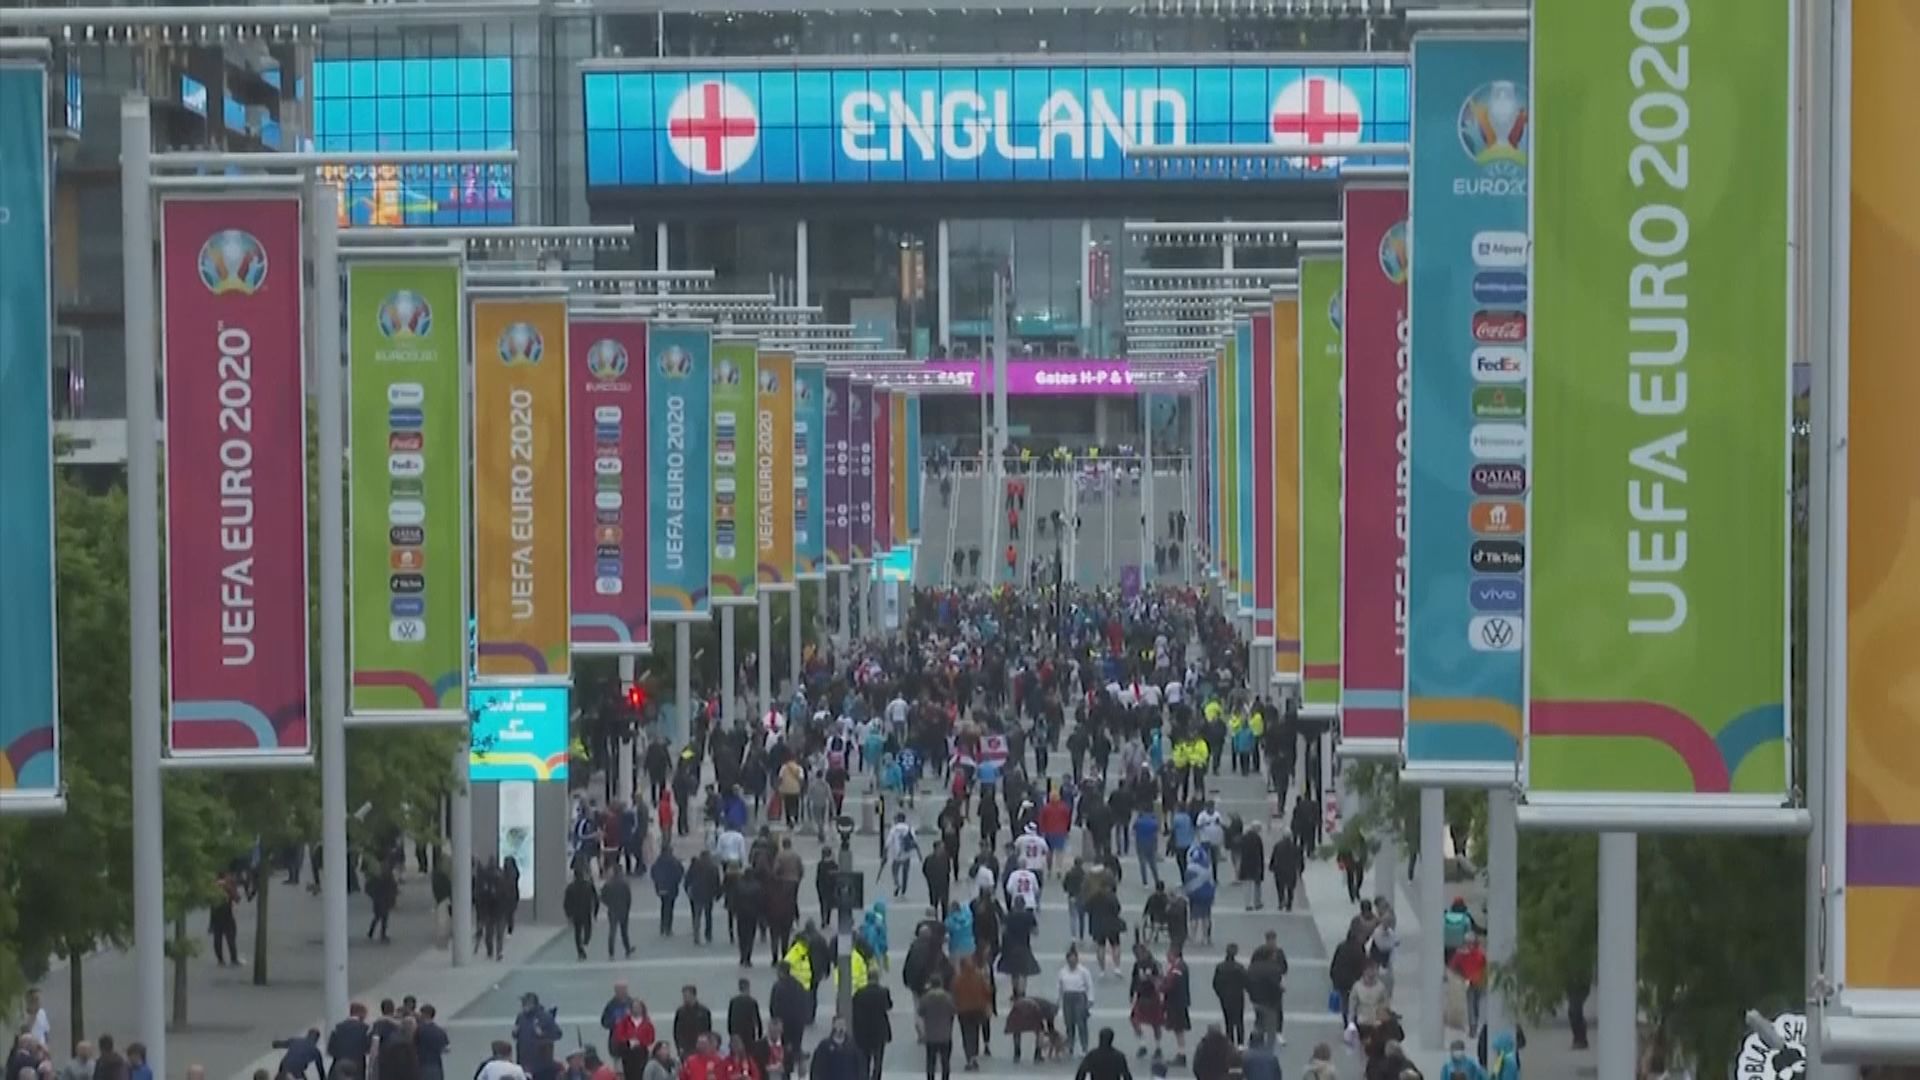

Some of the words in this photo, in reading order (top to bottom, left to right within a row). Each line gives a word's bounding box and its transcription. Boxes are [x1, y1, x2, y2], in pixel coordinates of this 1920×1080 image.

[1628, 0, 1690, 190] 2020
[841, 89, 1187, 161] ENGLAND
[1628, 203, 1689, 415] EURO
[218, 328, 252, 432] 2020
[1035, 370, 1077, 385] Gates
[1080, 370, 1107, 385] H-P
[1477, 357, 1521, 372] FedEx
[510, 389, 532, 461] 2020
[667, 396, 685, 451] 2020
[759, 410, 773, 456] 2020
[219, 439, 254, 550] EURO
[511, 464, 533, 541] EURO
[667, 452, 684, 510] EURO
[759, 457, 773, 504] EURO
[1475, 470, 1521, 484] QATAR
[666, 513, 684, 570] UEFA
[759, 505, 773, 550] UEFA
[1628, 429, 1688, 634] UEFA
[511, 546, 533, 620] UEFA
[1487, 552, 1522, 564] TikTok
[221, 557, 255, 666] UEFA
[1480, 588, 1517, 600] vivo
